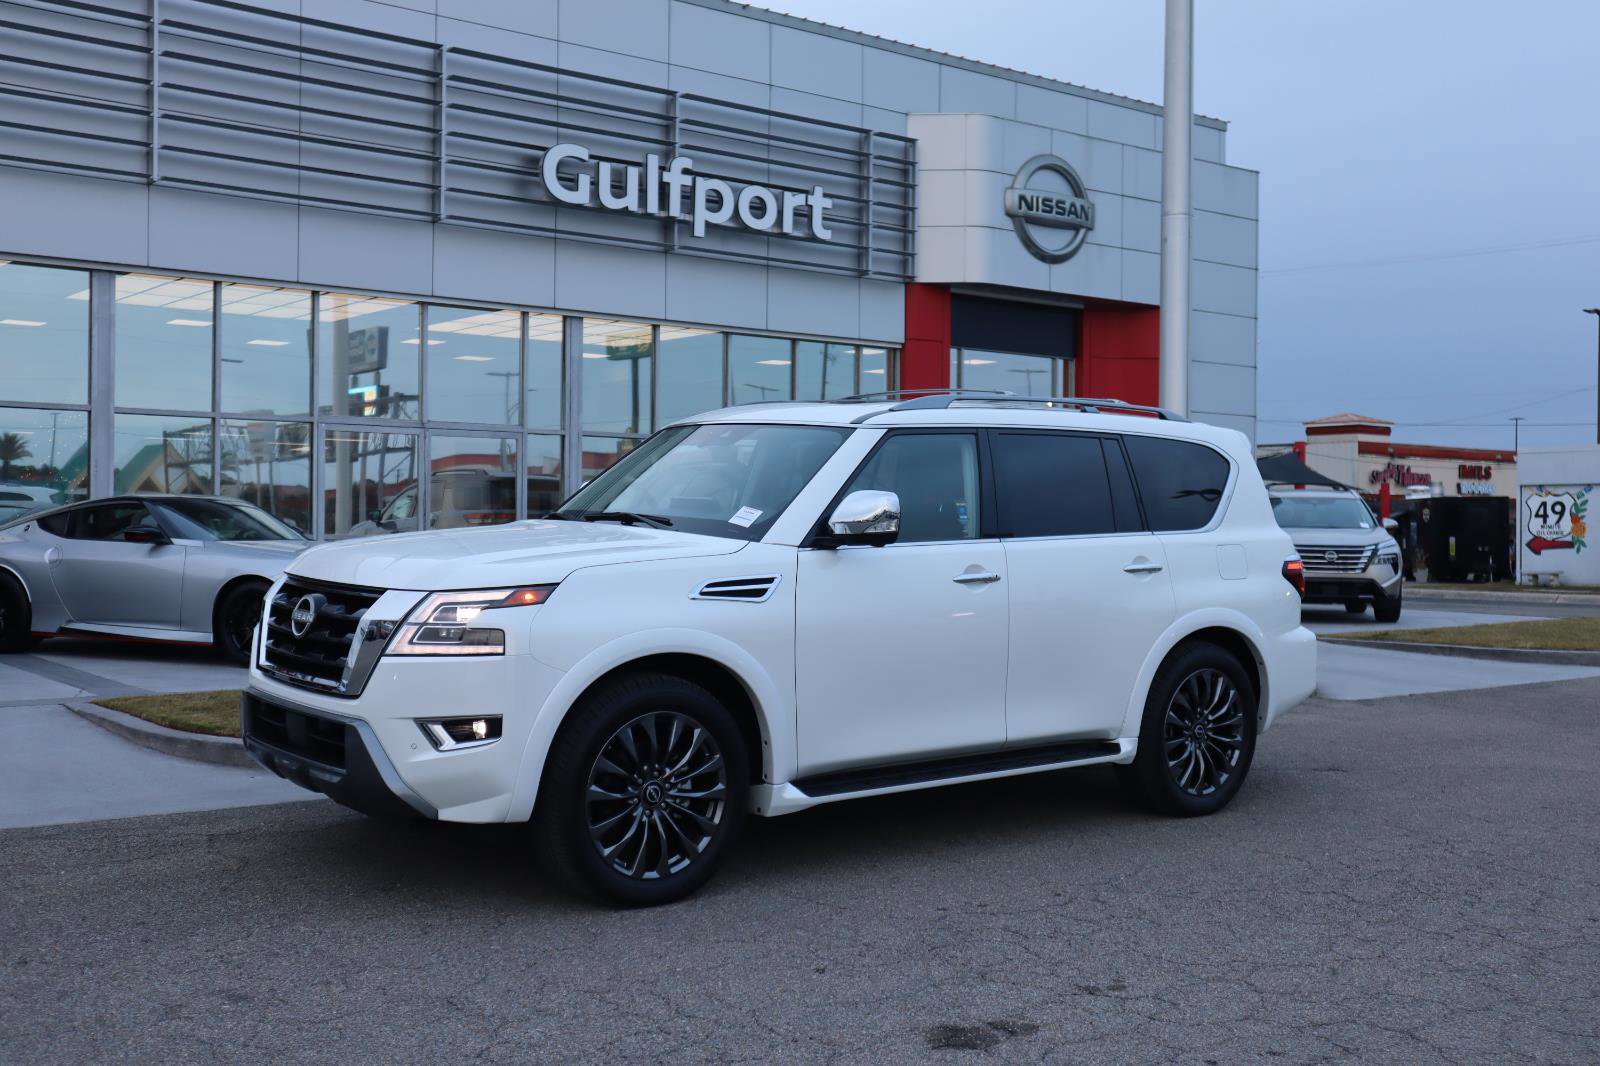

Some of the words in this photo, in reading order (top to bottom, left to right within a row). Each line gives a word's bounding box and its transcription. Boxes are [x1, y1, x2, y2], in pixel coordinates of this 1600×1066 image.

[541, 143, 833, 240] Gulfport
[1018, 194, 1090, 222] NISSAN
[1534, 501, 1566, 525] 49
